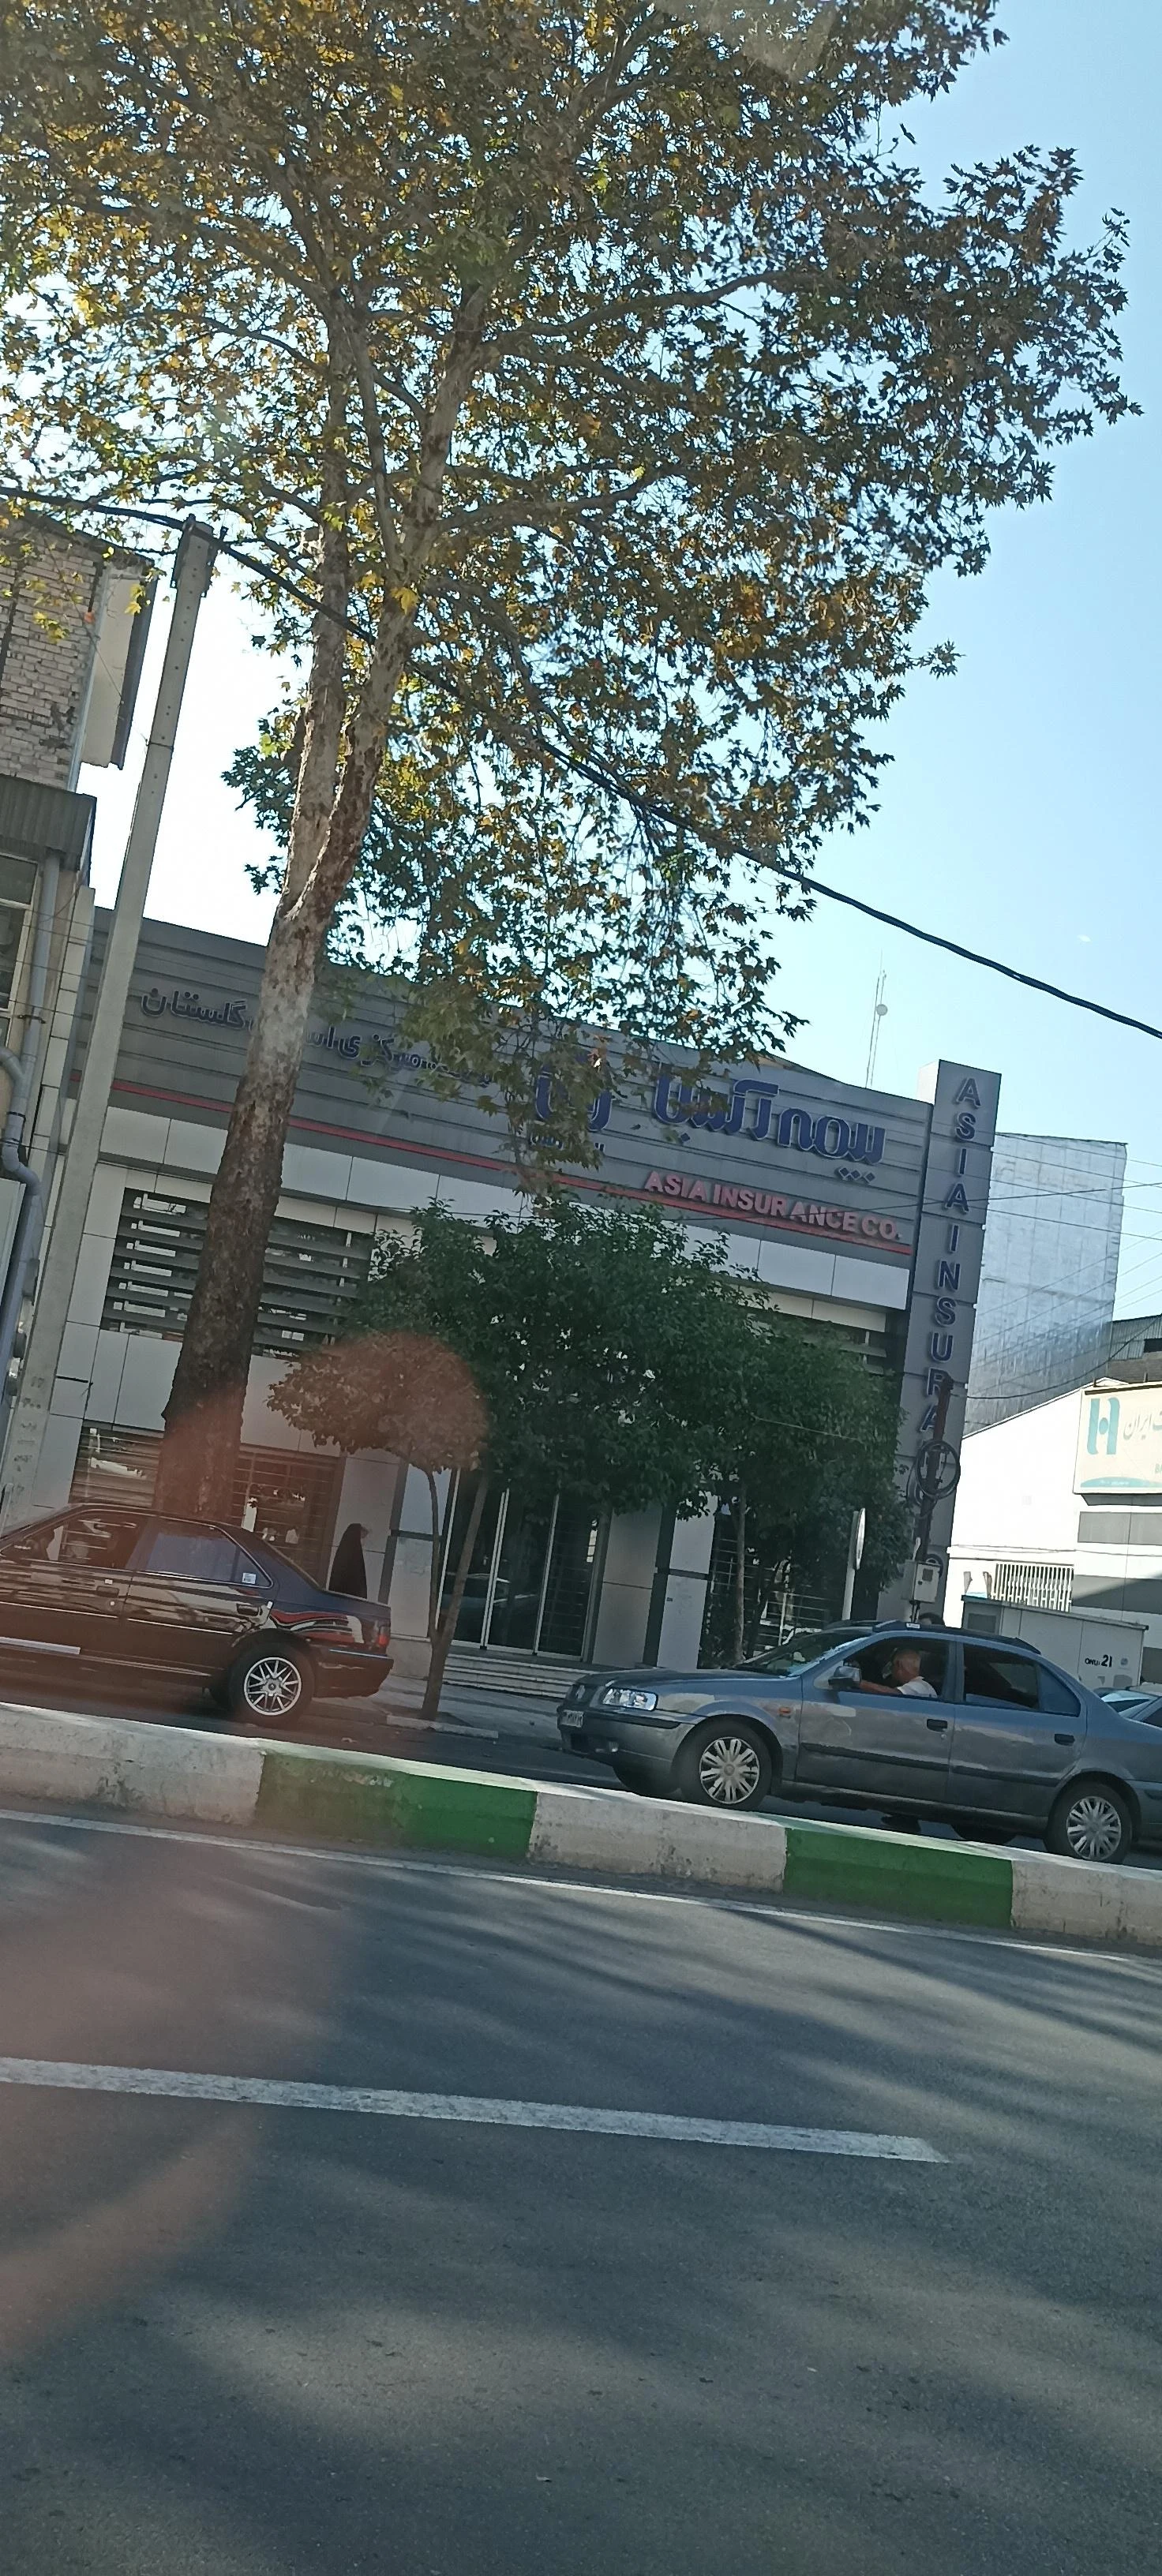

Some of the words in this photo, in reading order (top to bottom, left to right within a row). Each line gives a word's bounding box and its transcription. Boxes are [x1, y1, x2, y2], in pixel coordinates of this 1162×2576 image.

[141, 987, 247, 1030] گلستان
[777, 1107, 886, 1182] بیمه
[944, 1076, 982, 1215] ASIA
[644, 1170, 707, 1202] ASIA
[712, 1182, 857, 1233] INSURANCE
[1100, 1654, 1113, 1668] 21
